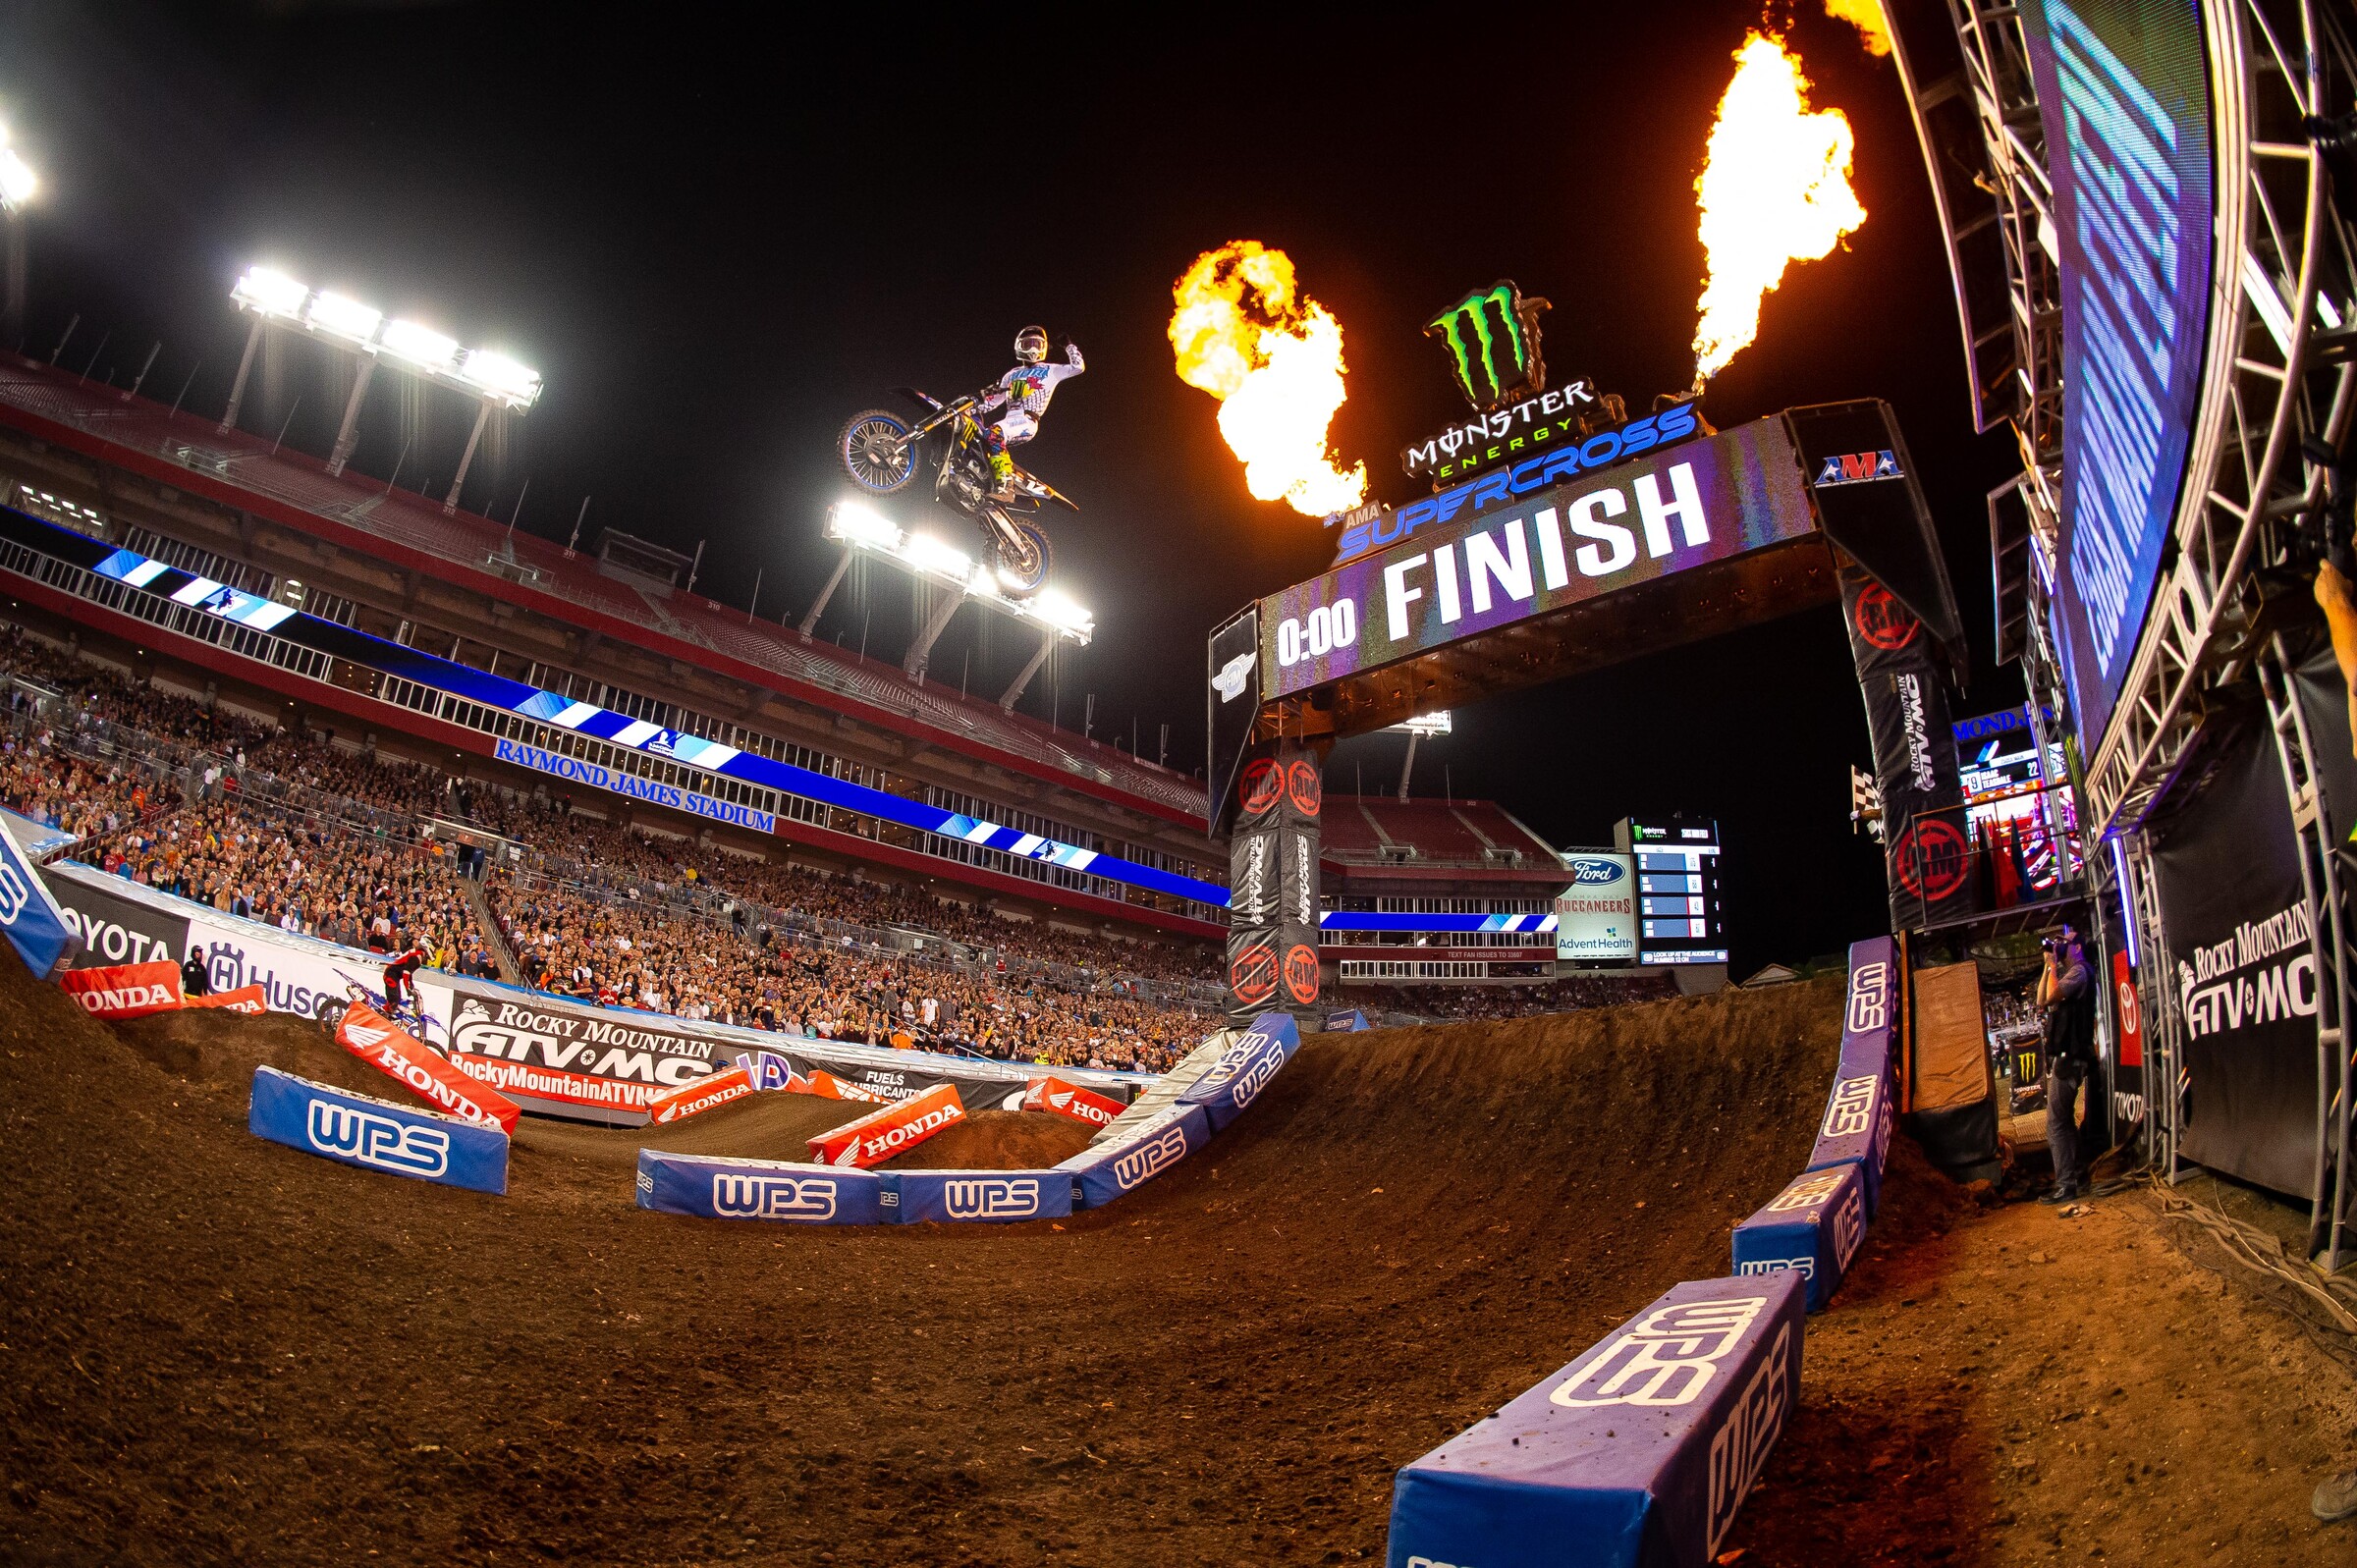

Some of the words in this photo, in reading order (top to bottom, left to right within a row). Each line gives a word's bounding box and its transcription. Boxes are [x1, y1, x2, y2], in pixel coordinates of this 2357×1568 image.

[1408, 380, 1594, 468] MONSTER
[1439, 417, 1572, 478] ENERGY
[1338, 403, 1696, 561] SUPERCROSS
[1813, 450, 1904, 484] AMA
[1345, 504, 1380, 529] AMA
[1278, 598, 1356, 667] 0:00
[1383, 460, 1711, 641] FINISH
[707, 600, 721, 611] 310
[1226, 666, 1241, 686] FIM
[1897, 676, 1915, 734] MOUNTAIN
[495, 738, 609, 787] RAYMOND
[610, 774, 682, 808] JAMES
[685, 794, 775, 834] STADIUM
[2027, 761, 2040, 778] 22
[1574, 860, 1612, 881] Ford
[1555, 898, 1630, 915] BUCCANEERS
[2194, 938, 2234, 984] ROCKY
[2234, 900, 2312, 967] MOUNTAIN
[495, 1003, 580, 1041] ROCKY
[581, 1020, 715, 1059] MOUNTAIN
[1328, 1018, 1354, 1031] WPS
[865, 1070, 904, 1086] FUELS
[1233, 1040, 1285, 1108] WPS
[679, 1083, 752, 1116] HONDA
[307, 1099, 450, 1178] WPS
[864, 1104, 962, 1158] HONDA
[1114, 1126, 1187, 1190] WPS
[713, 1173, 837, 1220] WPS
[945, 1179, 1039, 1218] WPS
